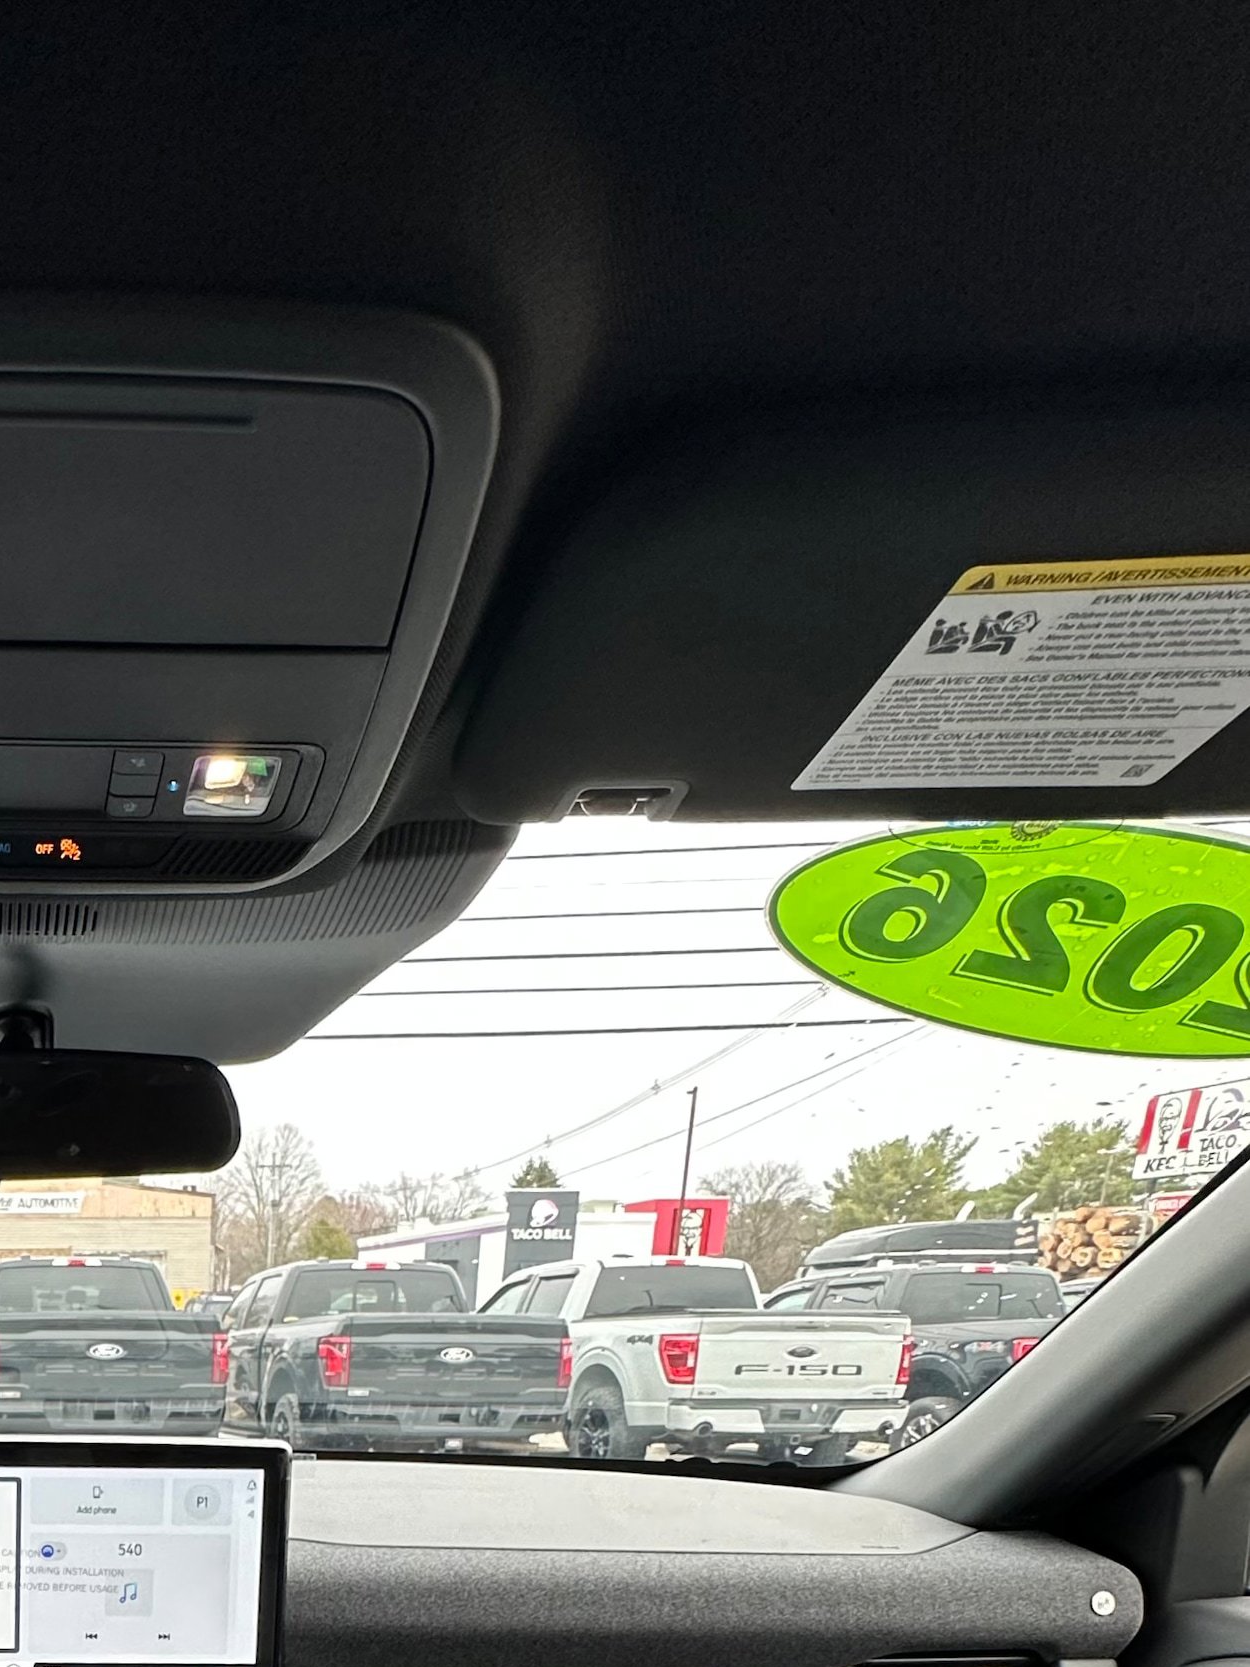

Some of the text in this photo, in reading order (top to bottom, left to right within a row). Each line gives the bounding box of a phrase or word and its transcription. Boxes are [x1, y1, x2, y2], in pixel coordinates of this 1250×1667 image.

[1006, 571, 1092, 587] WARNING
[1091, 592, 1137, 605] EVEN
[1139, 590, 1179, 604] WITH
[936, 676, 976, 685] AVEC
[977, 675, 1007, 685] DES
[1009, 674, 1050, 684] SACS
[1052, 671, 1152, 682] GONFLABLES
[36, 843, 54, 854] OFF
[1200, 1134, 1238, 1151] TACO
[1143, 1155, 1177, 1174] KFC
[17, 1197, 79, 1209] AUTOMOTIVE
[511, 1227, 573, 1241] TACO BELL
[734, 1364, 863, 1377] F-150
[76, 1506, 117, 1515] Add phone
[117, 1543, 143, 1556] 540
[25, 1567, 60, 1576] DURING
[62, 1567, 125, 1578] INSTALLATION
[52, 1583, 87, 1593] BEFORE
[89, 1584, 118, 1593] USAGE
